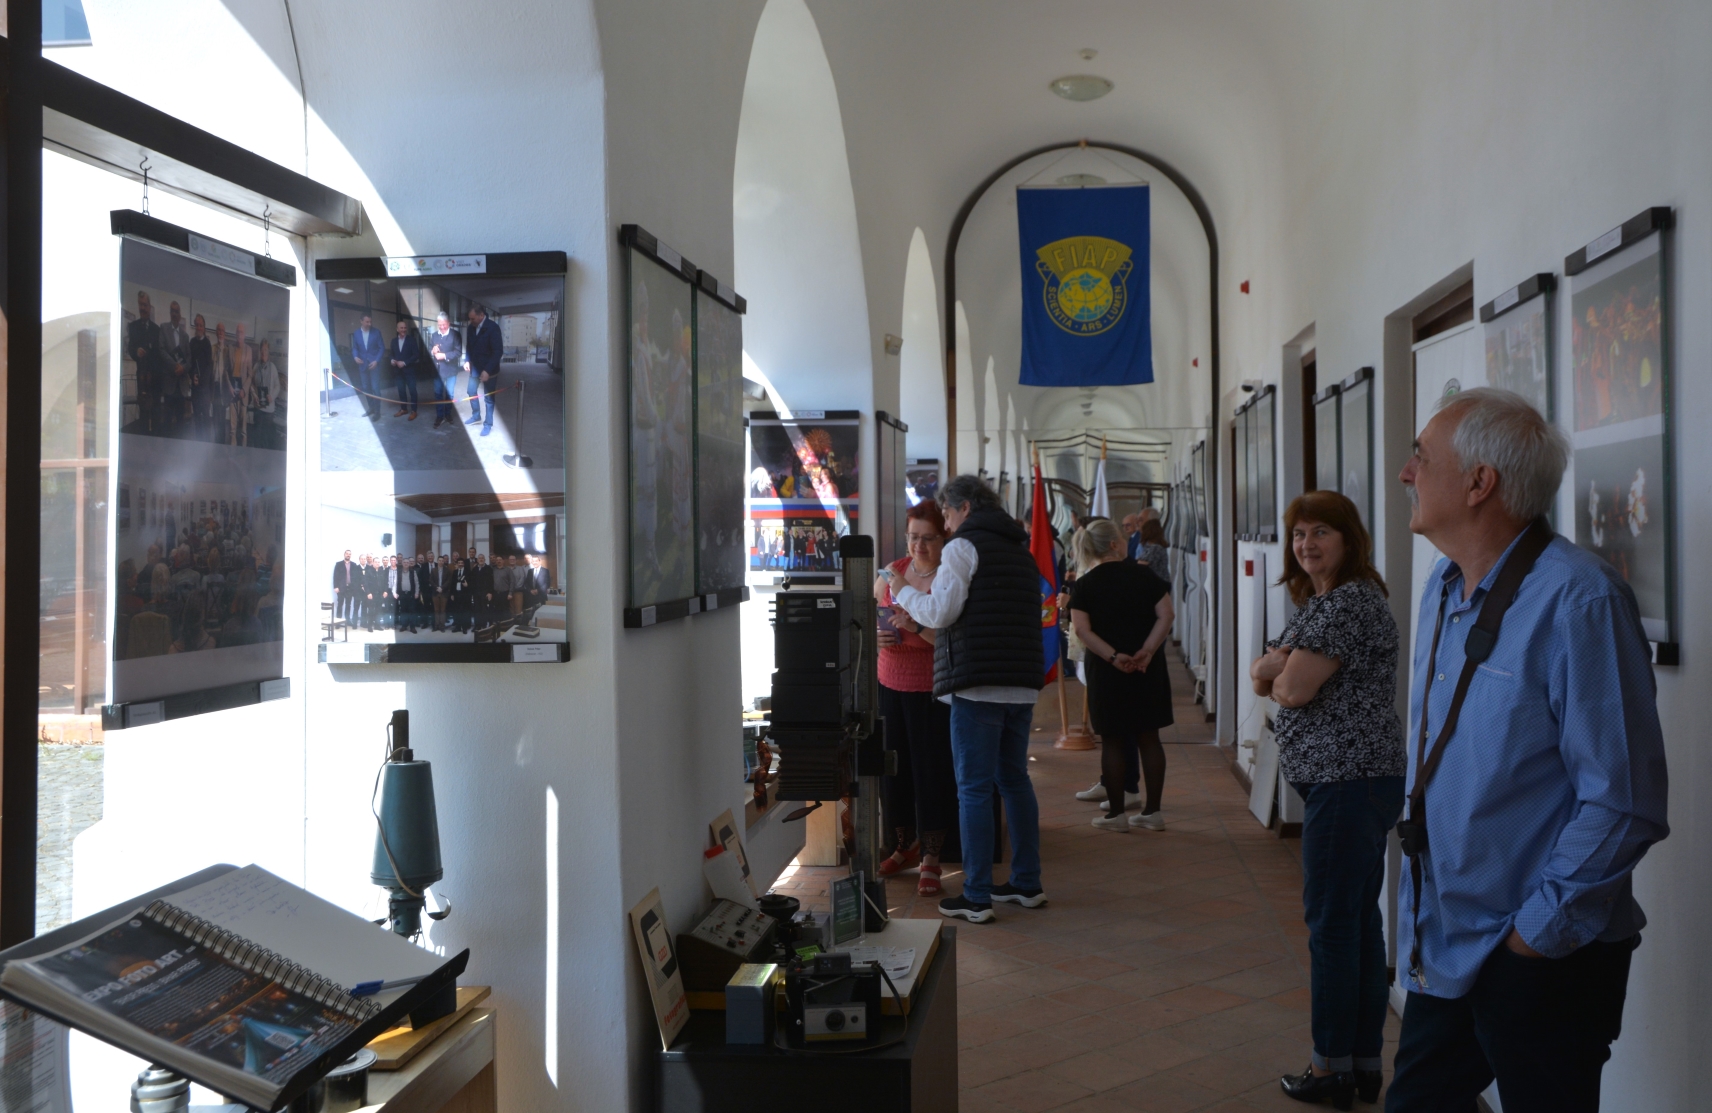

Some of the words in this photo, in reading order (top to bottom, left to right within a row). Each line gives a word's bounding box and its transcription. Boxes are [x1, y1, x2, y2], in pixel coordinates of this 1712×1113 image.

[1053, 244, 1118, 271] FIAP
[1048, 286, 1073, 328] SCIENTIA
[1081, 321, 1103, 331] ARS
[1106, 285, 1123, 320] LUMEN
[81, 981, 123, 1002] EXPO
[117, 965, 158, 987] FOTO
[155, 949, 183, 969] ART
